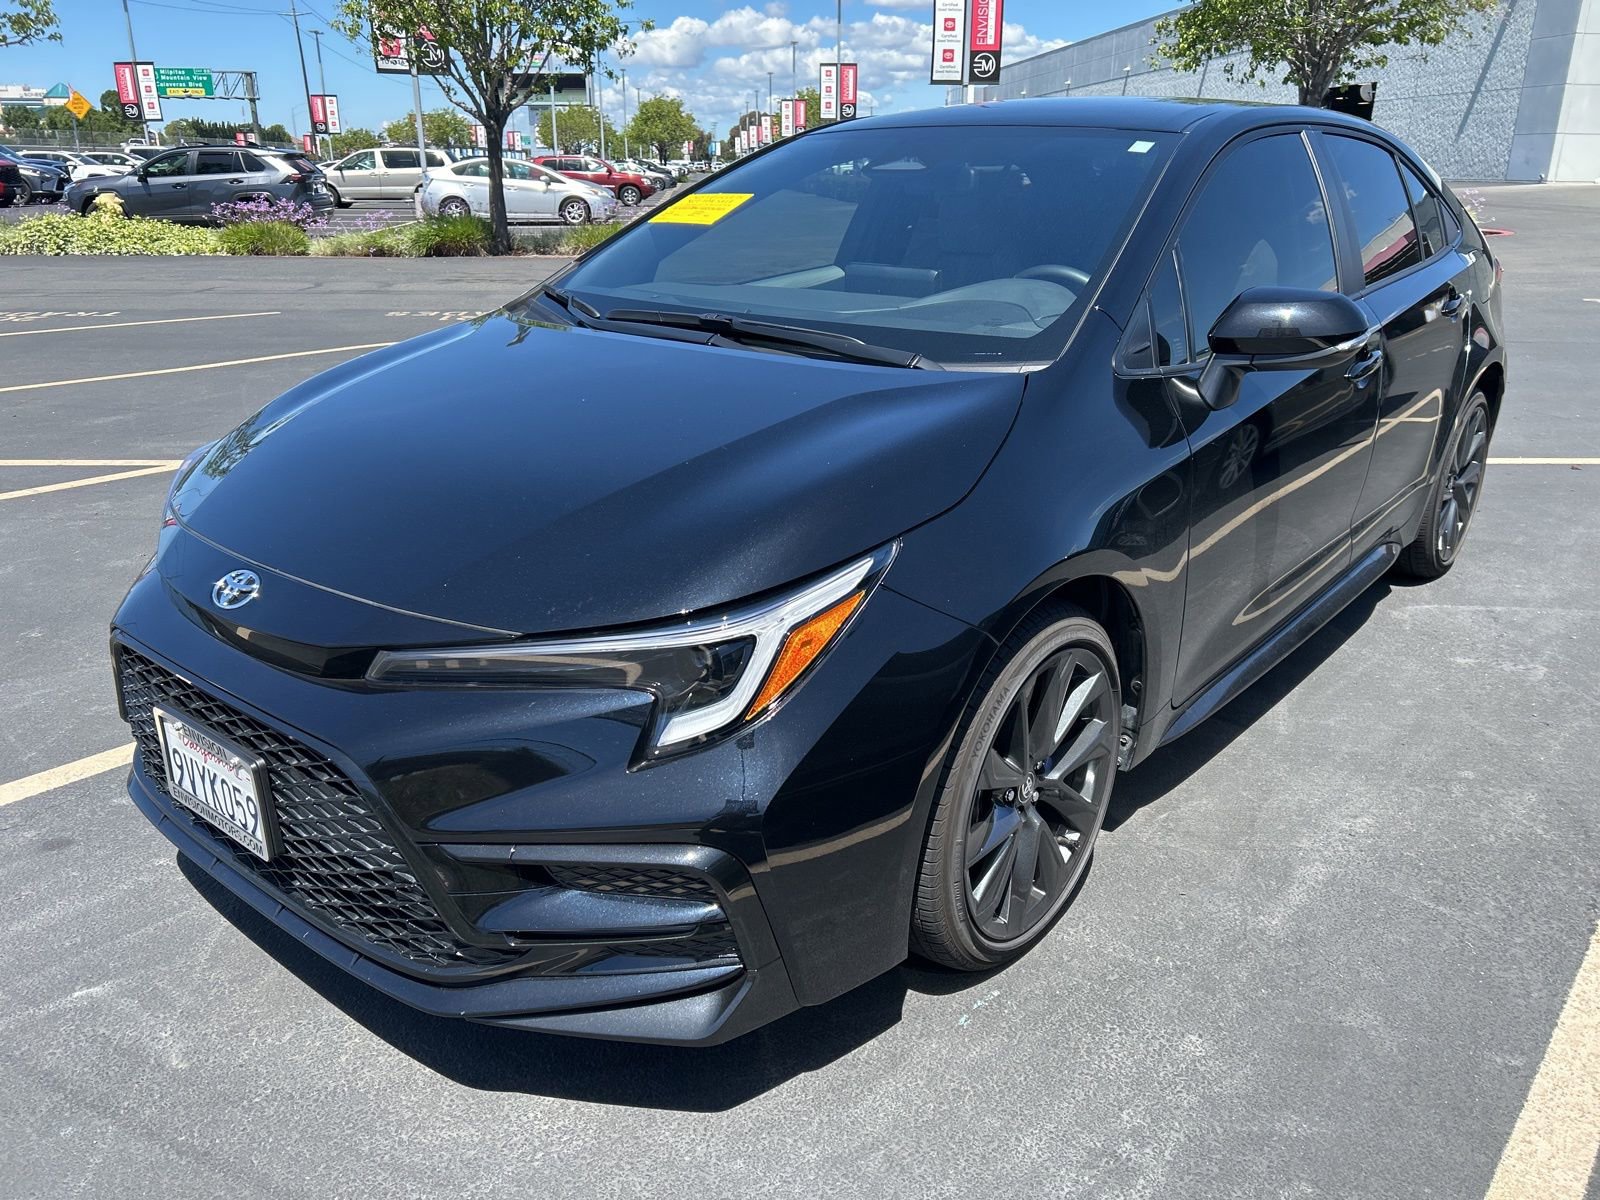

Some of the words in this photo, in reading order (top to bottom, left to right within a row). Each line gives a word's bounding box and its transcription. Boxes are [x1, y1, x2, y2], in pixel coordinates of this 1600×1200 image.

[182, 724, 228, 761] ENVISION
[971, 686, 1010, 758] YOKOHAMA
[173, 748, 259, 836] 9VYK059
[173, 787, 264, 857] ENVISIONMOTORS.COM
